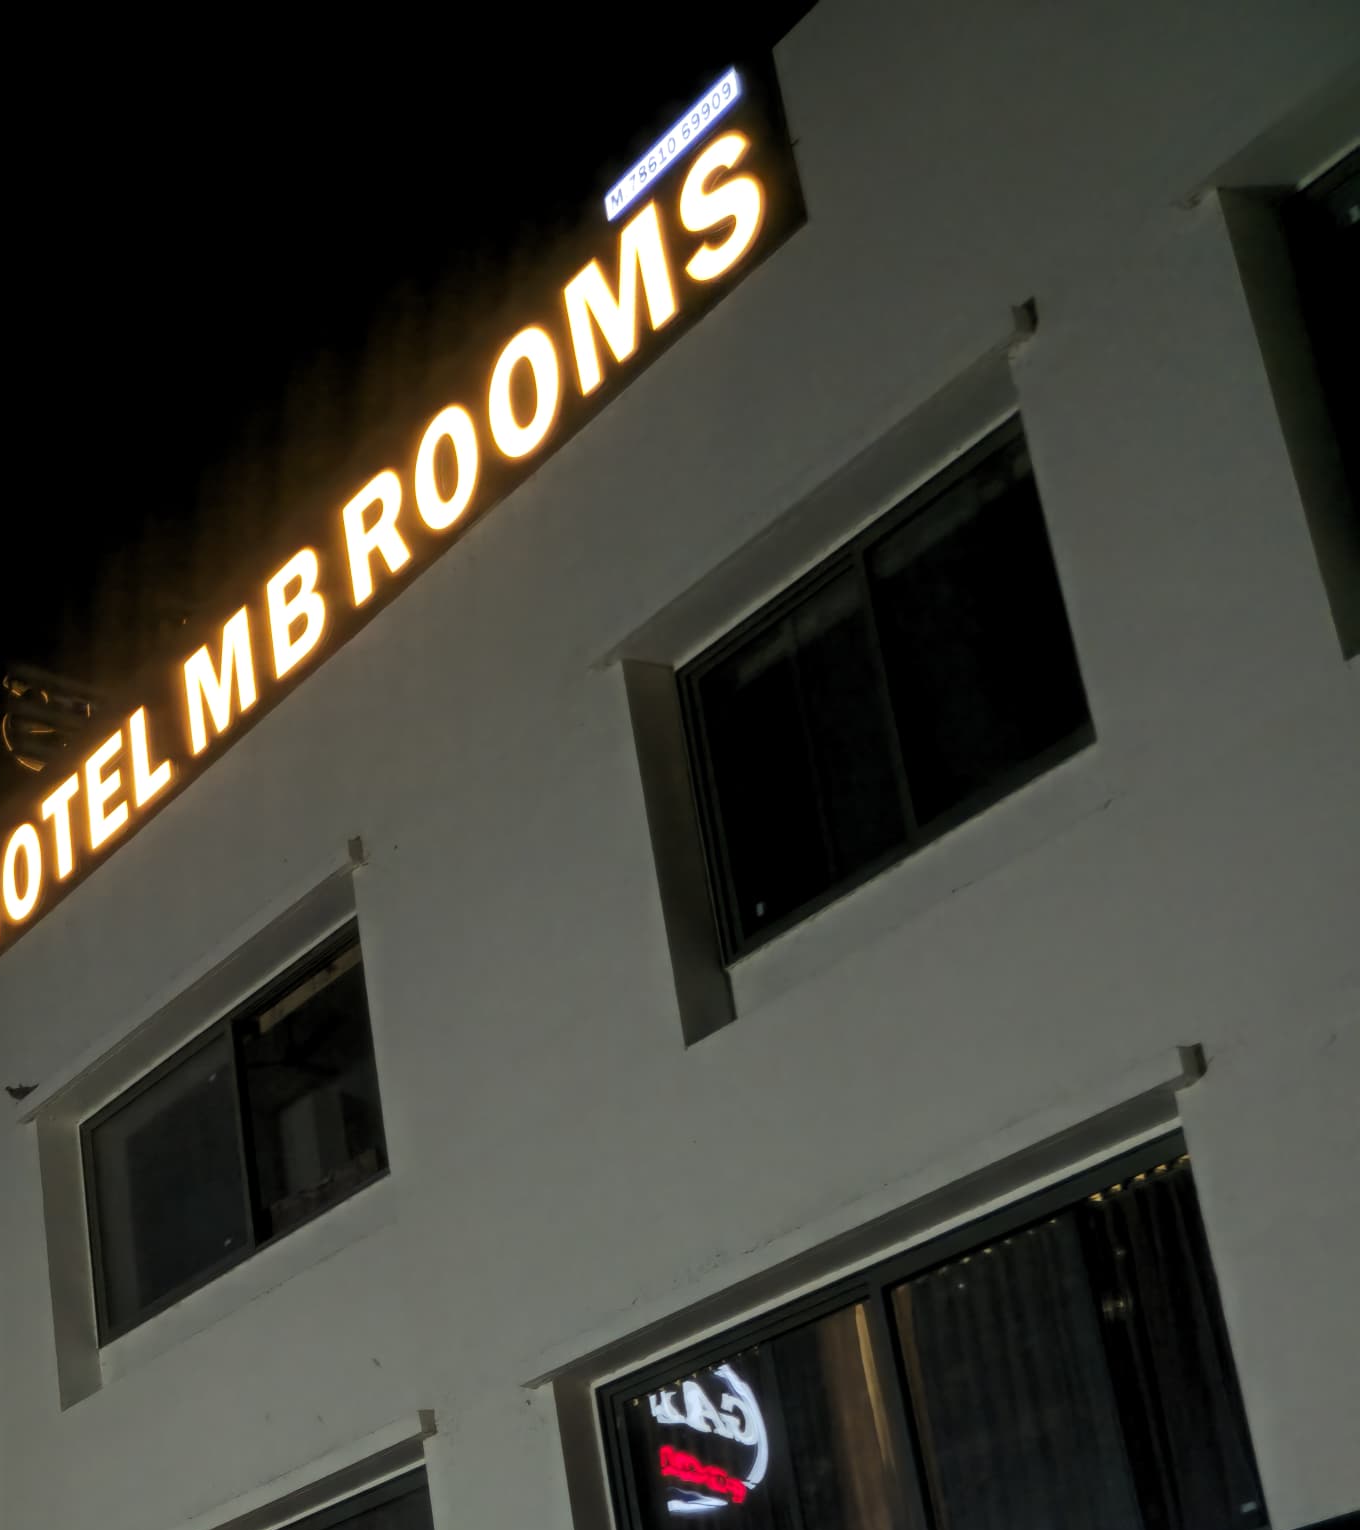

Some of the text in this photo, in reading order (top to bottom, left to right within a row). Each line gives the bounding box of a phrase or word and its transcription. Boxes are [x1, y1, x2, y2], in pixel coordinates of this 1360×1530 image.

[628, 137, 676, 191] 78610
[681, 81, 732, 140] 69909
[182, 546, 329, 756] MB
[341, 128, 768, 609] ROOMS
